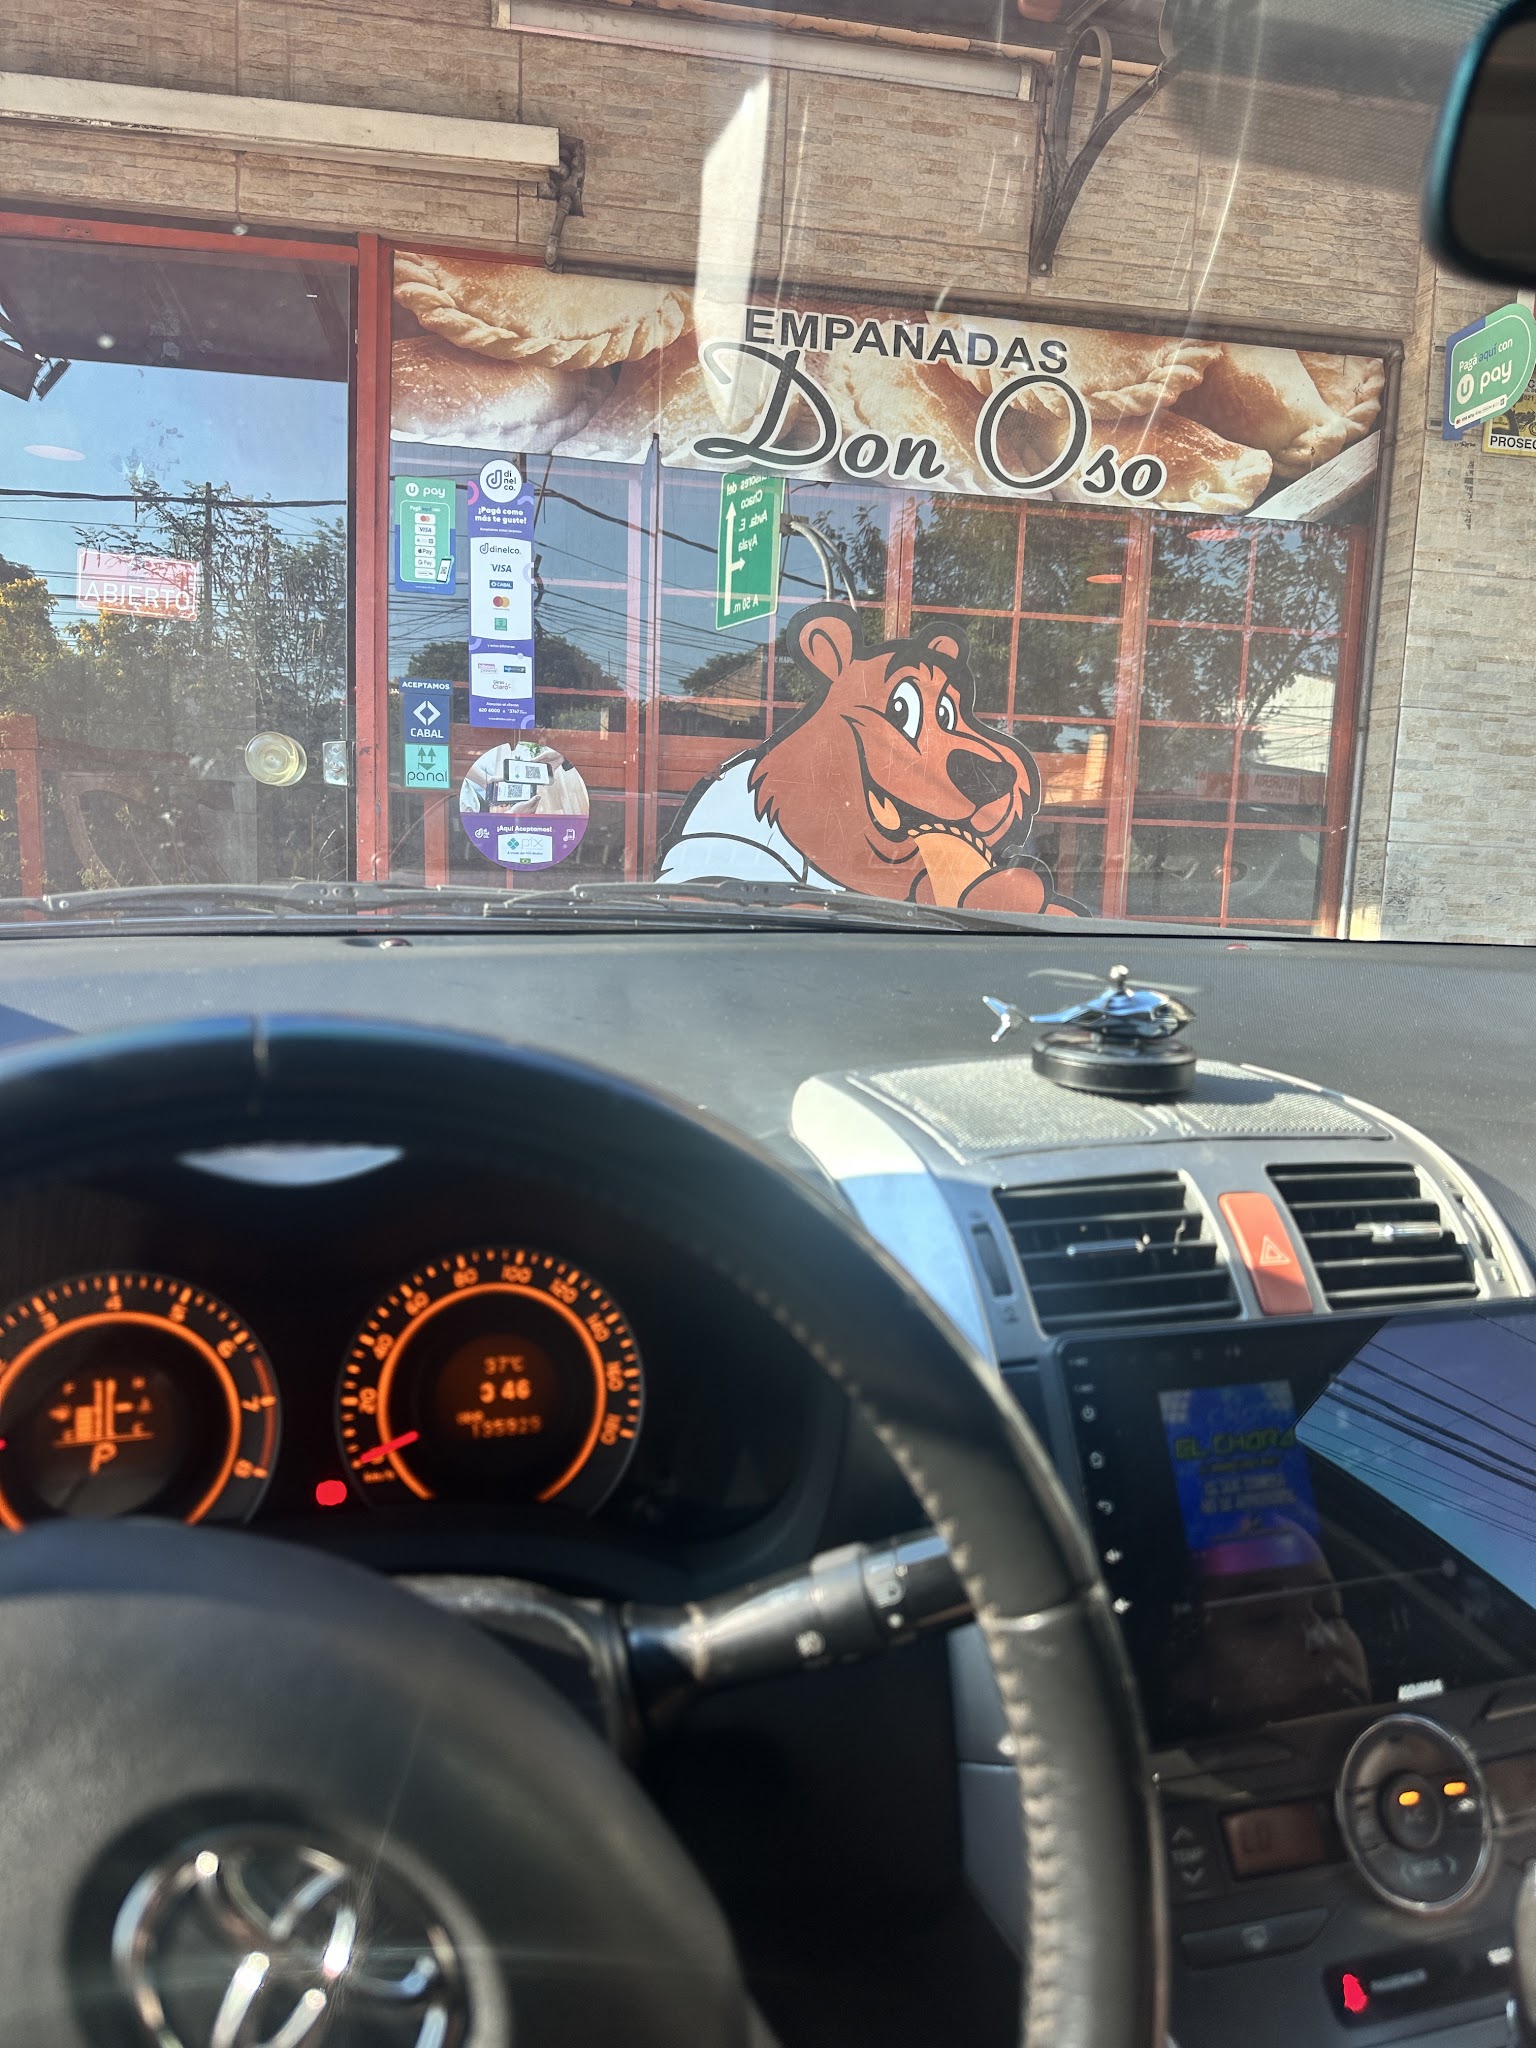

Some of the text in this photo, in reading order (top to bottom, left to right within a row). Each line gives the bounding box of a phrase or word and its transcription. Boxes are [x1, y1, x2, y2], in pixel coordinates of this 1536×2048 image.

[744, 307, 1067, 374] EMPANADAS
[1459, 338, 1513, 372] Pagá aquí con
[1479, 359, 1512, 395] pay
[693, 341, 1163, 497] Don Oso
[423, 487, 446, 499] pay
[491, 564, 512, 573] VISA
[84, 582, 190, 611] ABIERTO
[402, 681, 450, 690] ACEPTAMOS
[410, 728, 444, 738] CABAL
[407, 771, 447, 785] panal
[496, 825, 514, 833] ¡Aquí
[515, 825, 552, 833] Aceptamos!
[521, 838, 544, 849] pix
